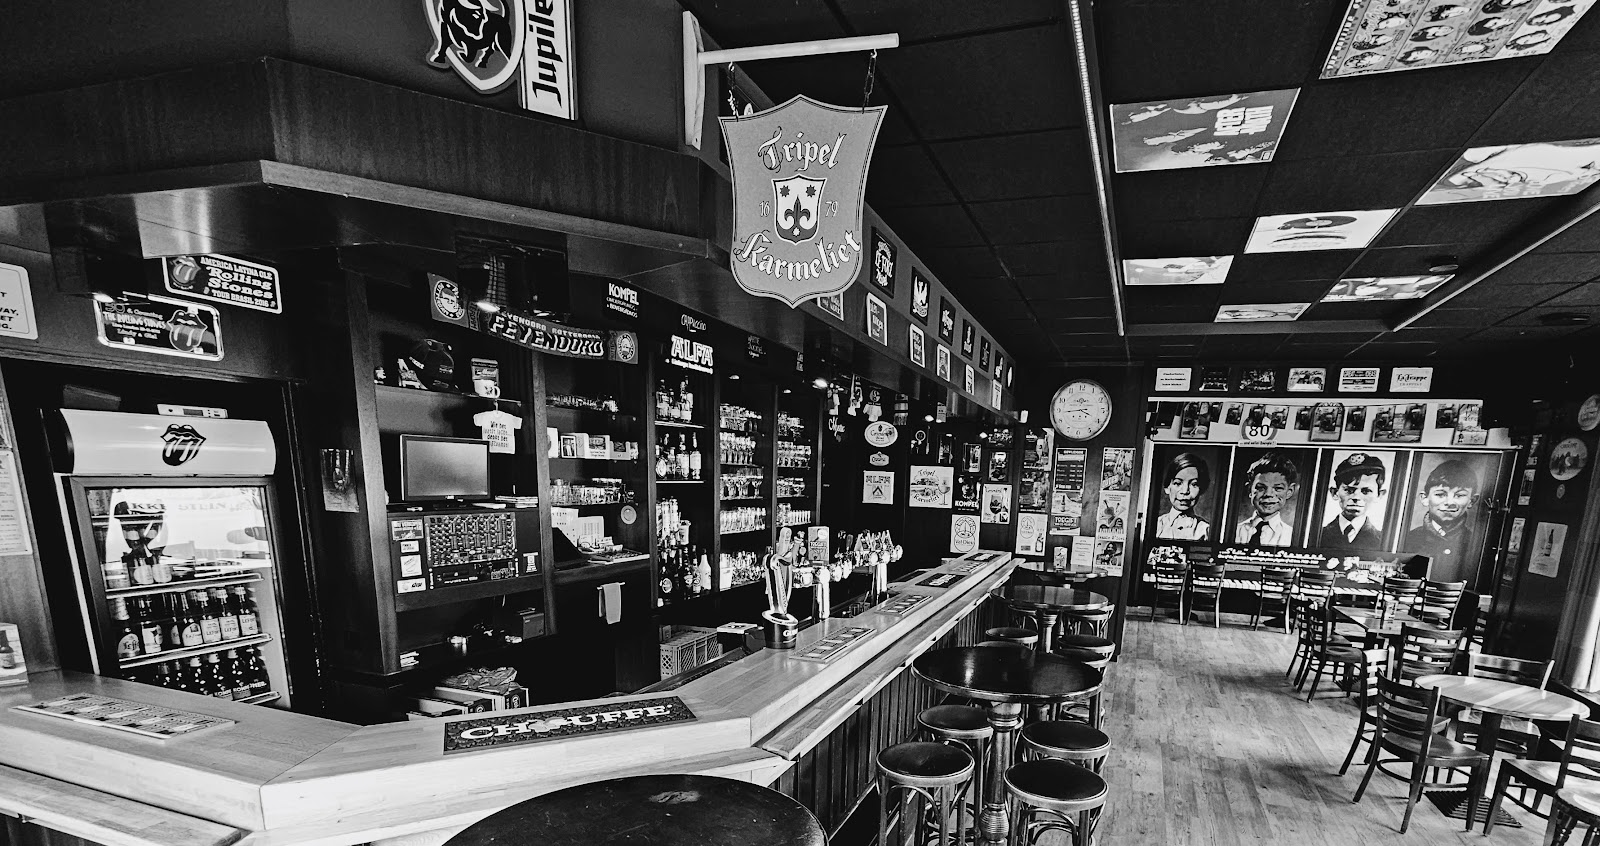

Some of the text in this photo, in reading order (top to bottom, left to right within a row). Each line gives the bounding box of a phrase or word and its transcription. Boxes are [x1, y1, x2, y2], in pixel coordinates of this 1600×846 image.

[757, 125, 847, 173] Tripel
[758, 200, 839, 217] 16 79
[732, 230, 862, 282] Karmeliet
[206, 266, 273, 291] Rolling
[207, 277, 274, 299] Stones
[211, 289, 231, 300] TOUR
[230, 292, 255, 305] BRASIL
[608, 282, 639, 306] KOMPEL
[102, 311, 116, 321] THE
[671, 333, 714, 367] ALFA
[1249, 424, 1270, 437] 80
[954, 499, 979, 509] KOMPEL
